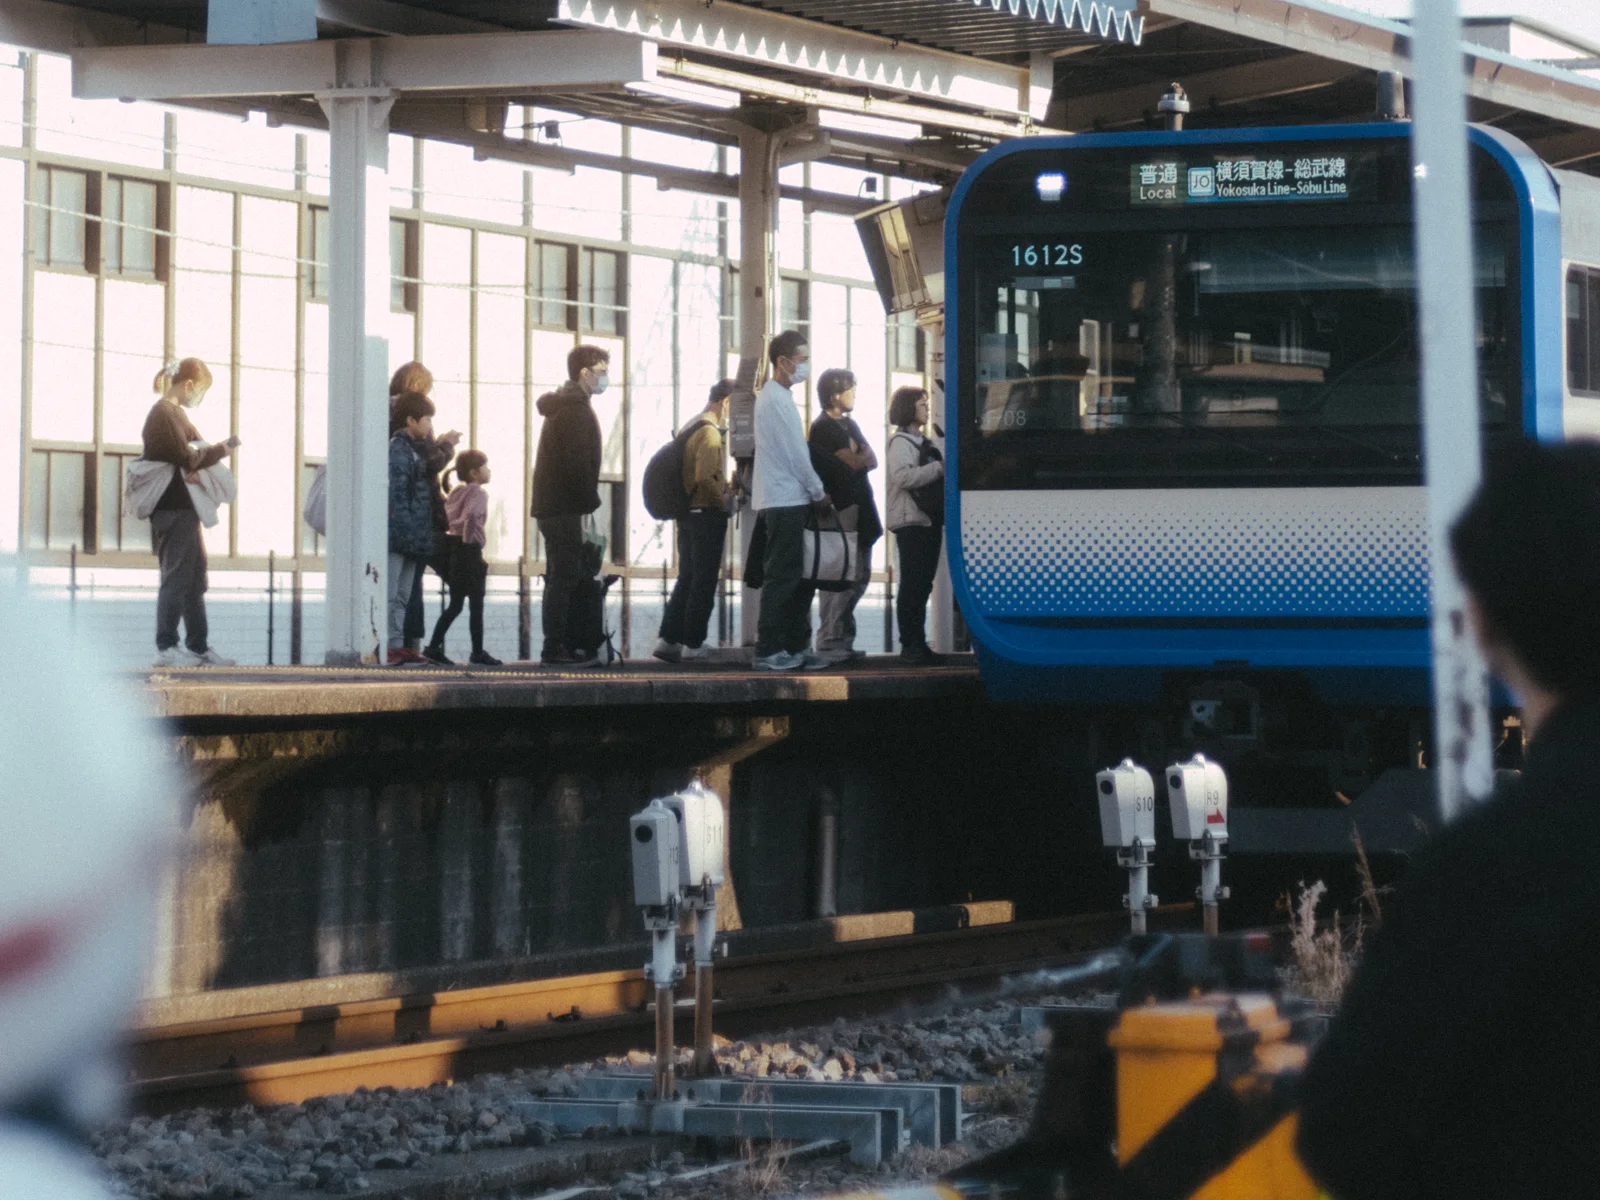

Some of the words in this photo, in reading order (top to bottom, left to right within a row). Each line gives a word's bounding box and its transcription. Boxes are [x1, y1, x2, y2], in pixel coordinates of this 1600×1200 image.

[1139, 162, 1178, 185] 普通
[1193, 174, 1210, 189] JO
[1140, 185, 1177, 200] Local
[1216, 182, 1266, 198] Yokosuka
[1323, 179, 1347, 194] Line
[1012, 243, 1083, 266] 1612S
[1136, 796, 1153, 813] S10
[1206, 790, 1219, 806] R9
